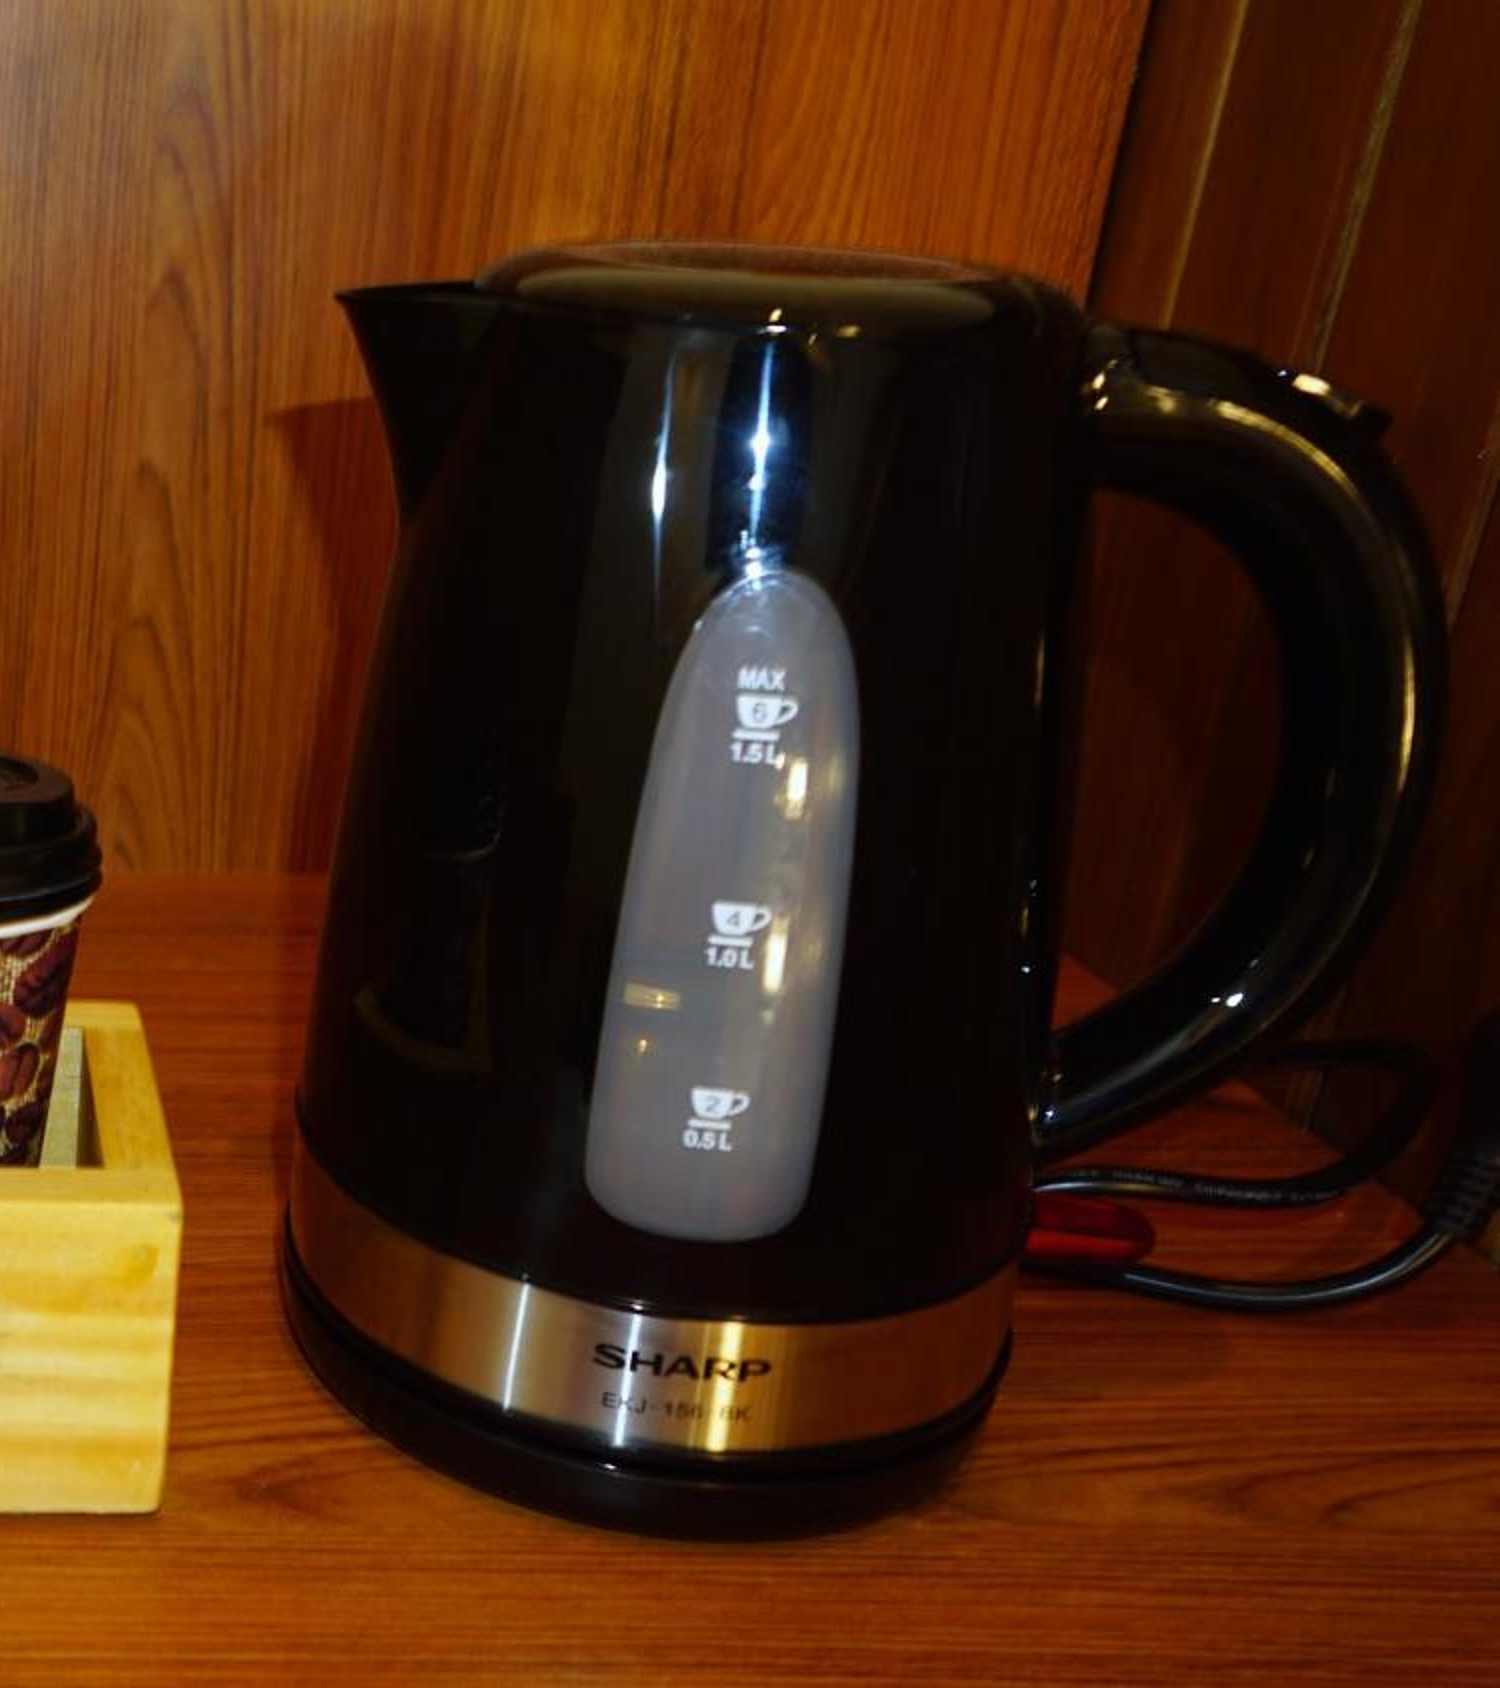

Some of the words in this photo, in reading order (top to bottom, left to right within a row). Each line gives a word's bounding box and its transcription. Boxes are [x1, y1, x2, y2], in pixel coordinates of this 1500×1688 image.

[737, 666, 786, 692] MAX
[752, 702, 767, 723] 6
[593, 1343, 772, 1383] SHARP
